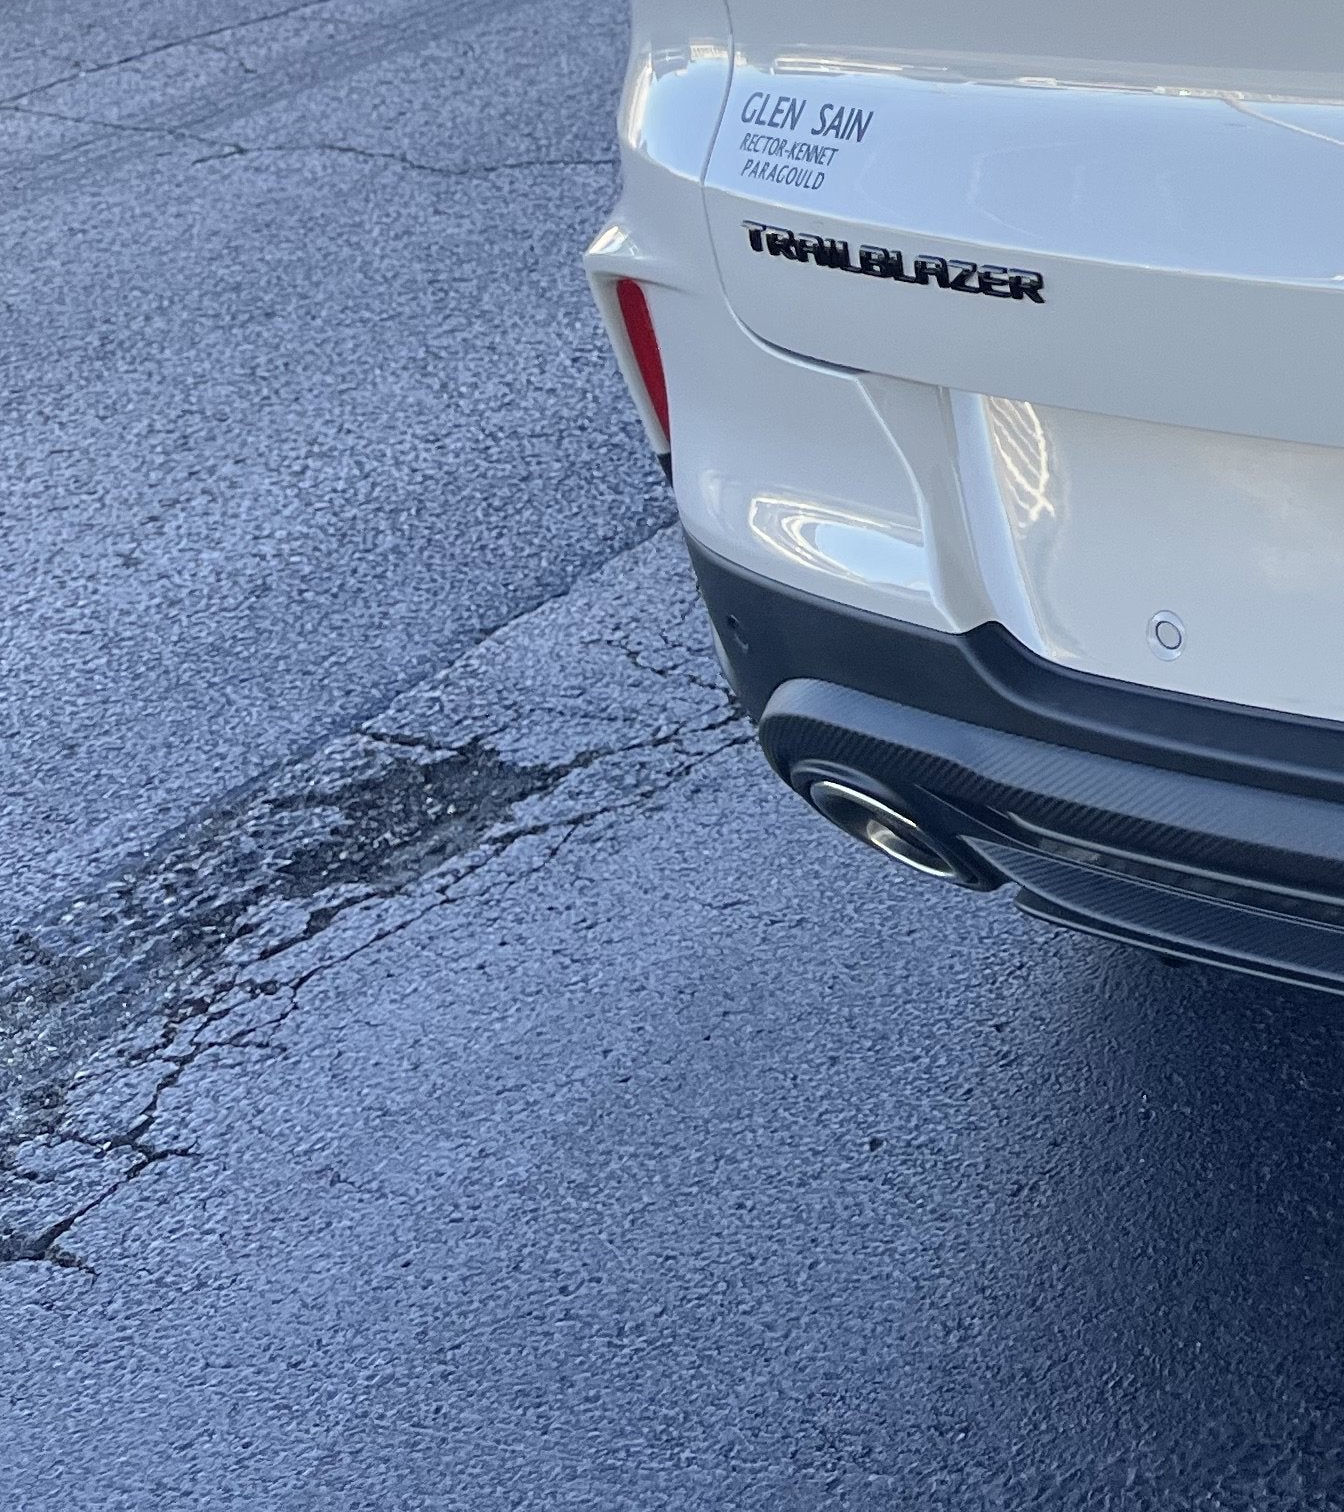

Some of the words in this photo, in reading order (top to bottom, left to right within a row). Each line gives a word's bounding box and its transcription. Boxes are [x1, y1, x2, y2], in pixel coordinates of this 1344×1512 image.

[740, 91, 807, 131] GLEN
[810, 103, 875, 143] SAIN
[740, 159, 826, 190] PARAGOULD
[741, 219, 1046, 304] TRAILBLAZER
